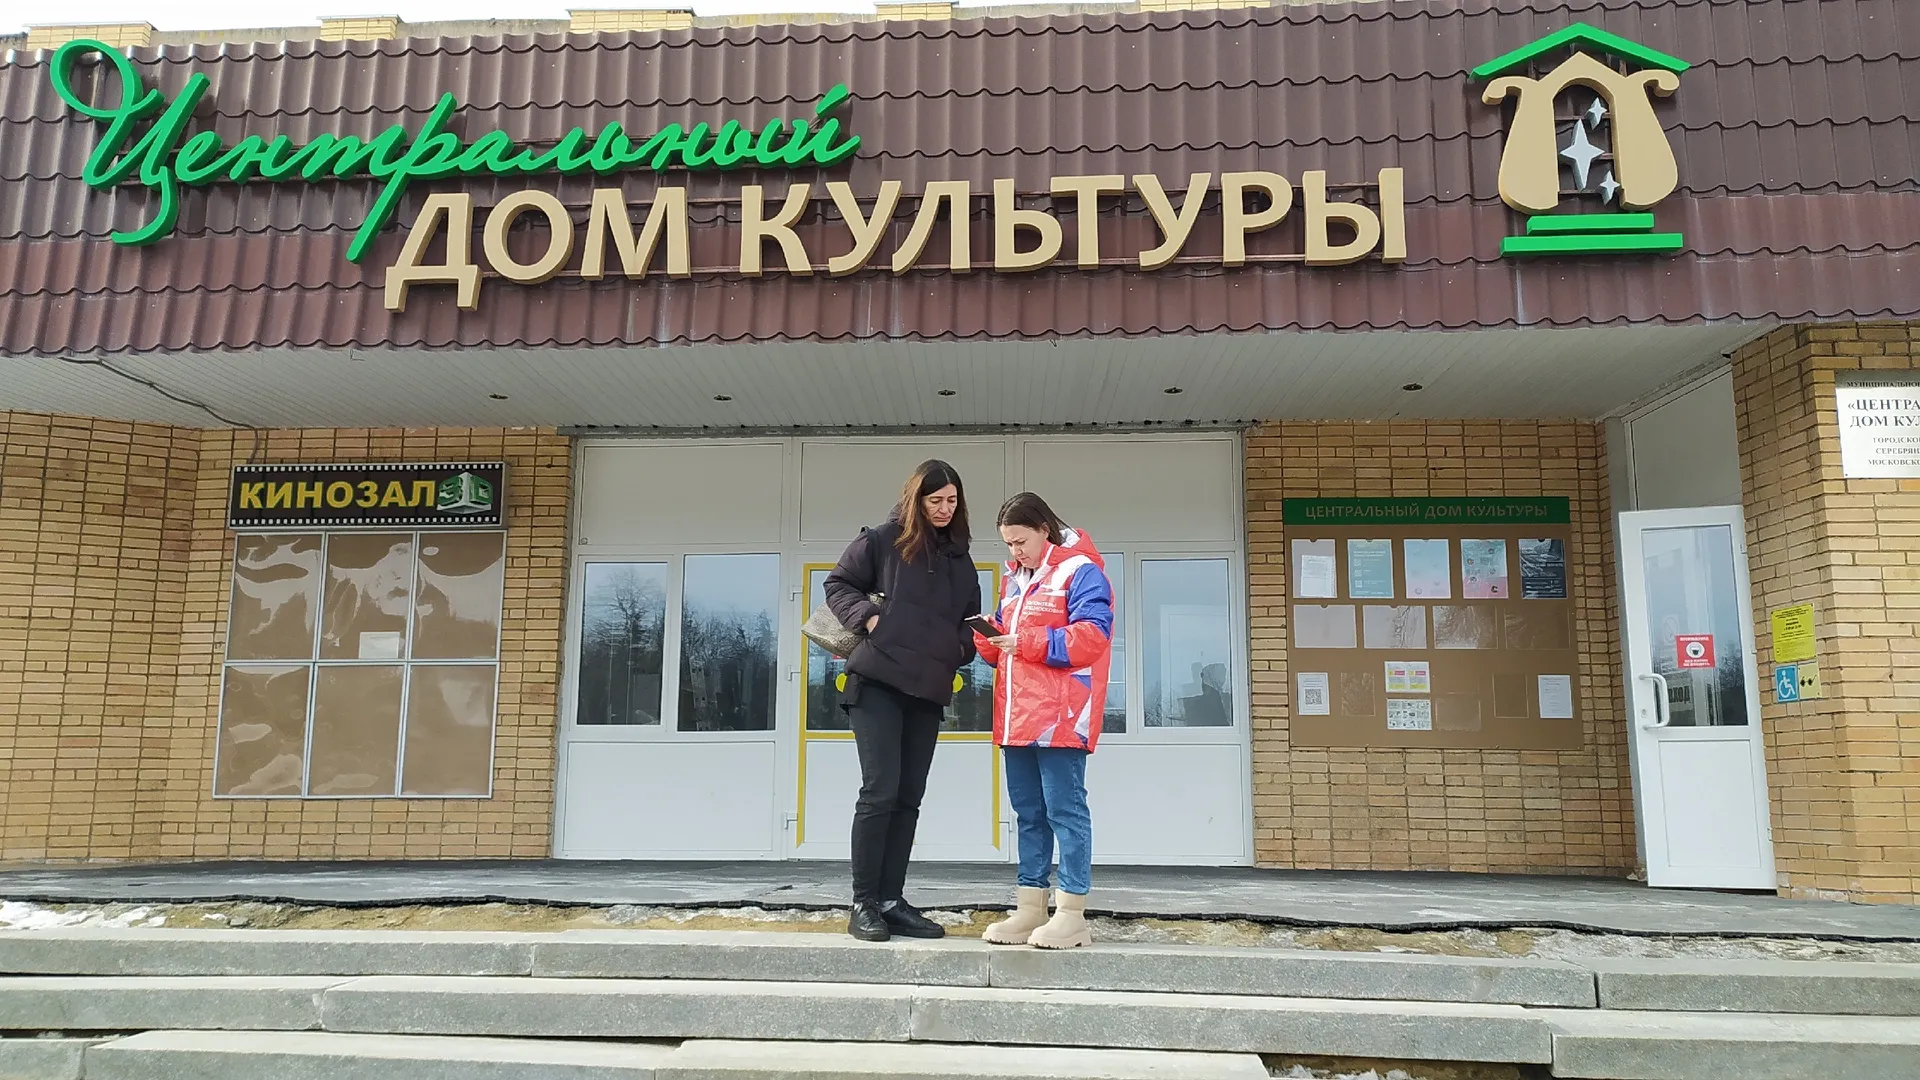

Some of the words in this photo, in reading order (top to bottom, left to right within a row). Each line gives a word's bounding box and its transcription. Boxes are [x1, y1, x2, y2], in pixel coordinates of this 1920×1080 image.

[50, 38, 862, 263] Центральный
[384, 185, 690, 311] ДОМ
[738, 166, 1407, 278] КУЛЬТУРЫ
[1849, 415, 1888, 428] ДОМ
[239, 480, 436, 509] КИНОЗАЛ
[1306, 502, 1420, 520] ЦЕНТРАЛЬНЫЙ
[1424, 505, 1462, 520] ДОМ
[1467, 505, 1547, 517] КУЛЬТУРЫ
